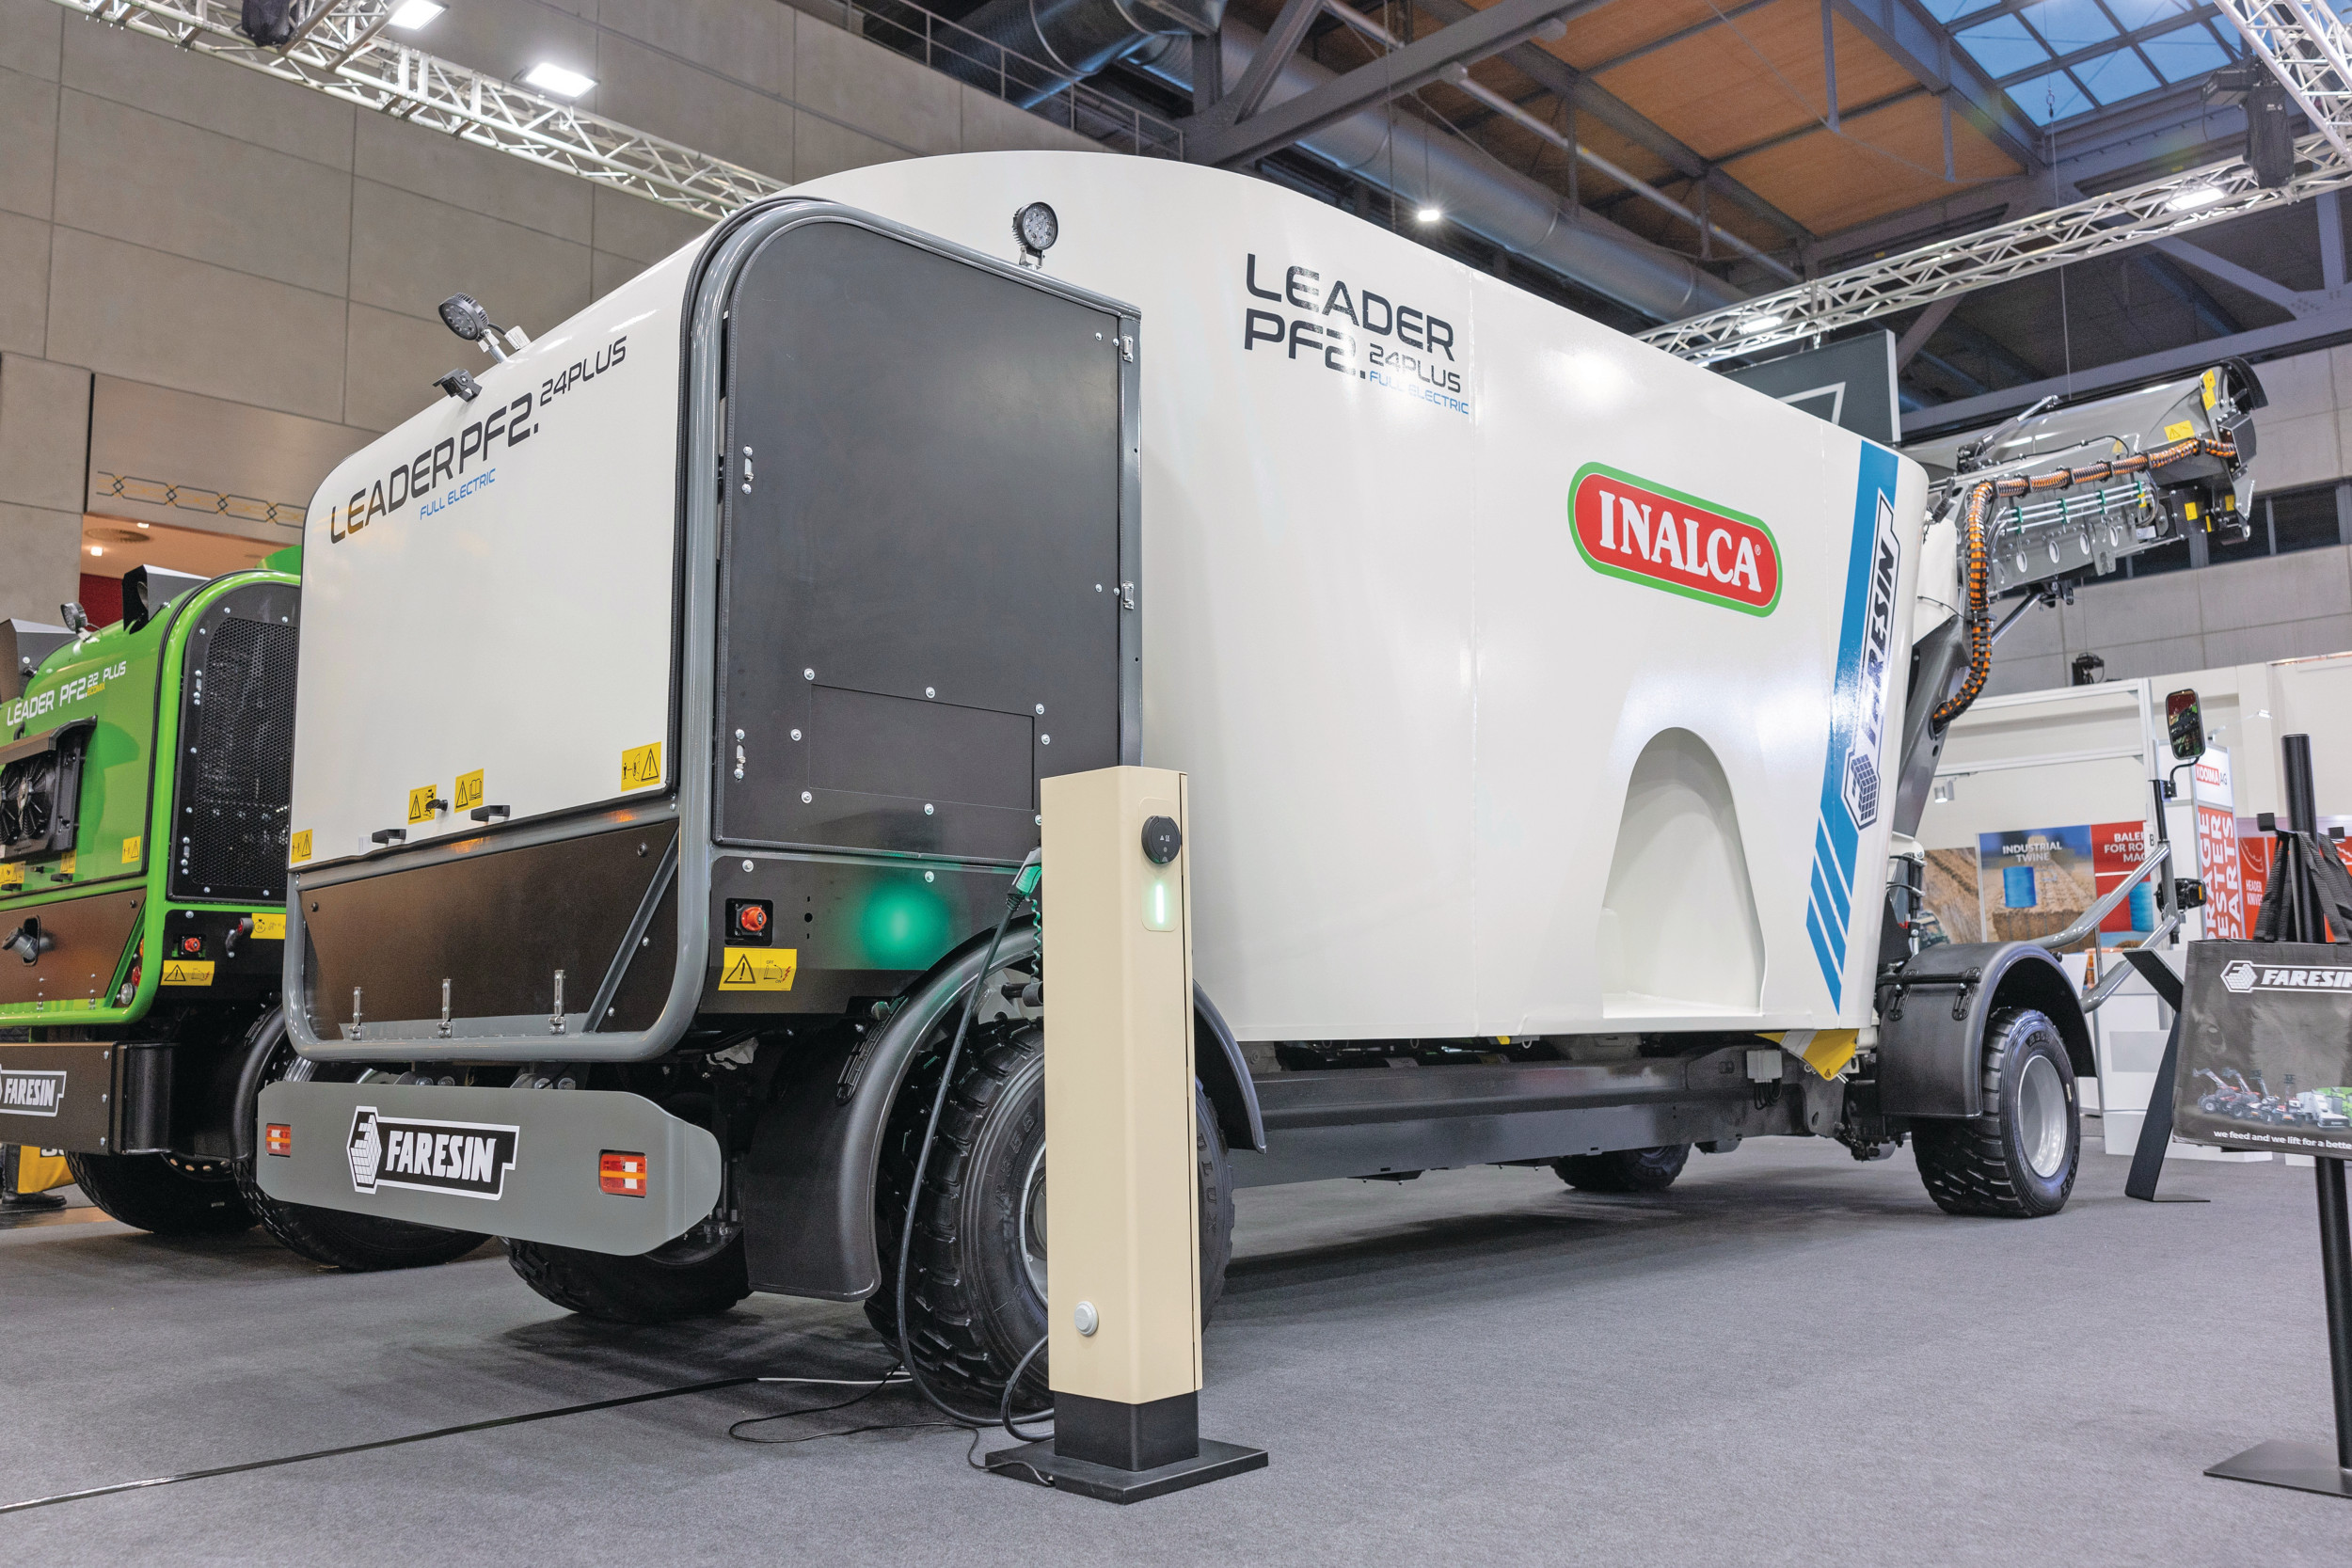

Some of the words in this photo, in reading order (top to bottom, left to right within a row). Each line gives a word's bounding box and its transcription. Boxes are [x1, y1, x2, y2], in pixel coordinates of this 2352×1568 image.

[1246, 253, 1454, 362] LEADER
[1408, 384, 1470, 414] ELECTRIC
[330, 436, 454, 545] LEADER
[420, 494, 446, 520] FULL
[447, 467, 496, 506] ELECTRIC
[7, 689, 56, 727] LEADER
[87, 672, 99, 689] 22
[103, 660, 127, 683] PLUS
[2196, 765, 2219, 784] KOOIMA
[2219, 772, 2228, 785] AG
[2002, 840, 2063, 855] INDUSTRIAL
[2015, 852, 2051, 863] TWINE
[2104, 845, 2125, 854] FOR
[2245, 879, 2263, 893] HEADER
[4, 1078, 56, 1106] FARESIN
[2229, 1132, 2251, 1140] feed
[2287, 1135, 2301, 1145] lift
[2301, 1137, 2316, 1147] for
[386, 1131, 497, 1182] FARESIN
